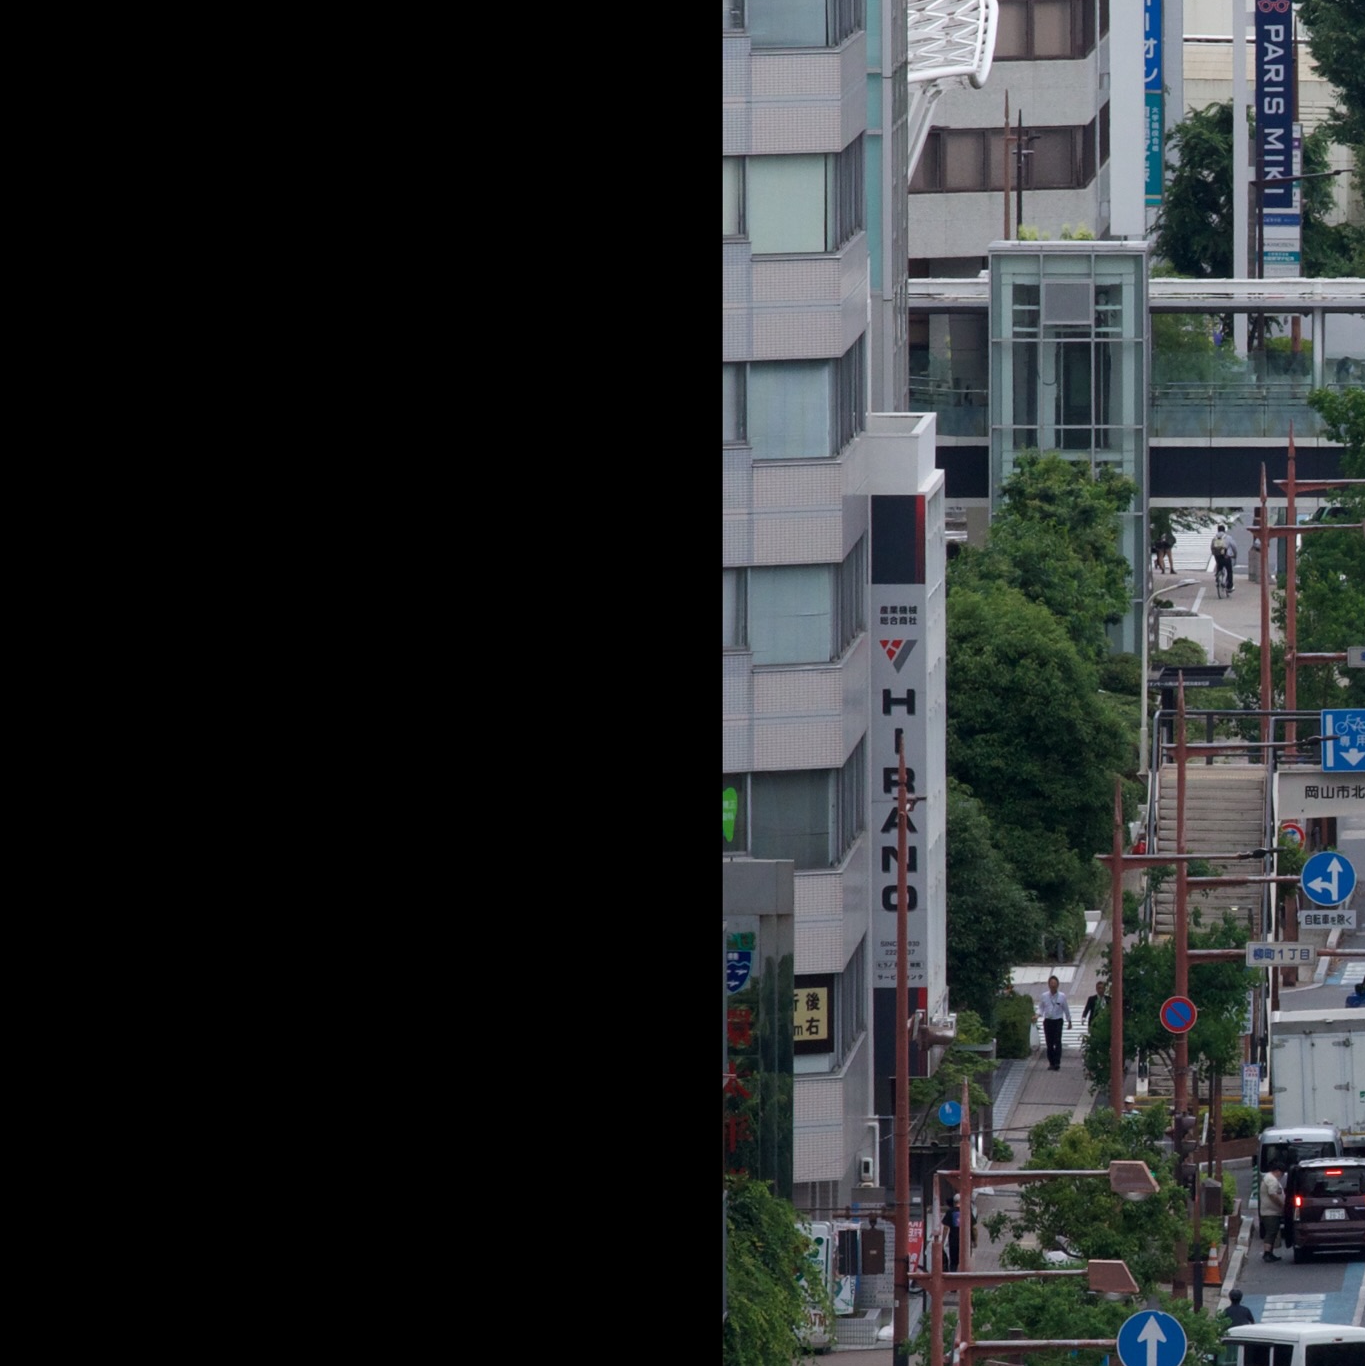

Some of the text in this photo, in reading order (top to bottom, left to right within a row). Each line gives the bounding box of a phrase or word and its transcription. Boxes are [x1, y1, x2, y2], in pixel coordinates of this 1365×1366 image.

[1263, 24, 1284, 115] PARIS
[1263, 128, 1285, 194] MIKI
[879, 606, 917, 615] 産業機械
[879, 616, 917, 625] 総合商社
[880, 689, 918, 912] HIRANO
[1304, 914, 1352, 925] 自転車を除く
[1253, 948, 1311, 960] 柳町1丁目
